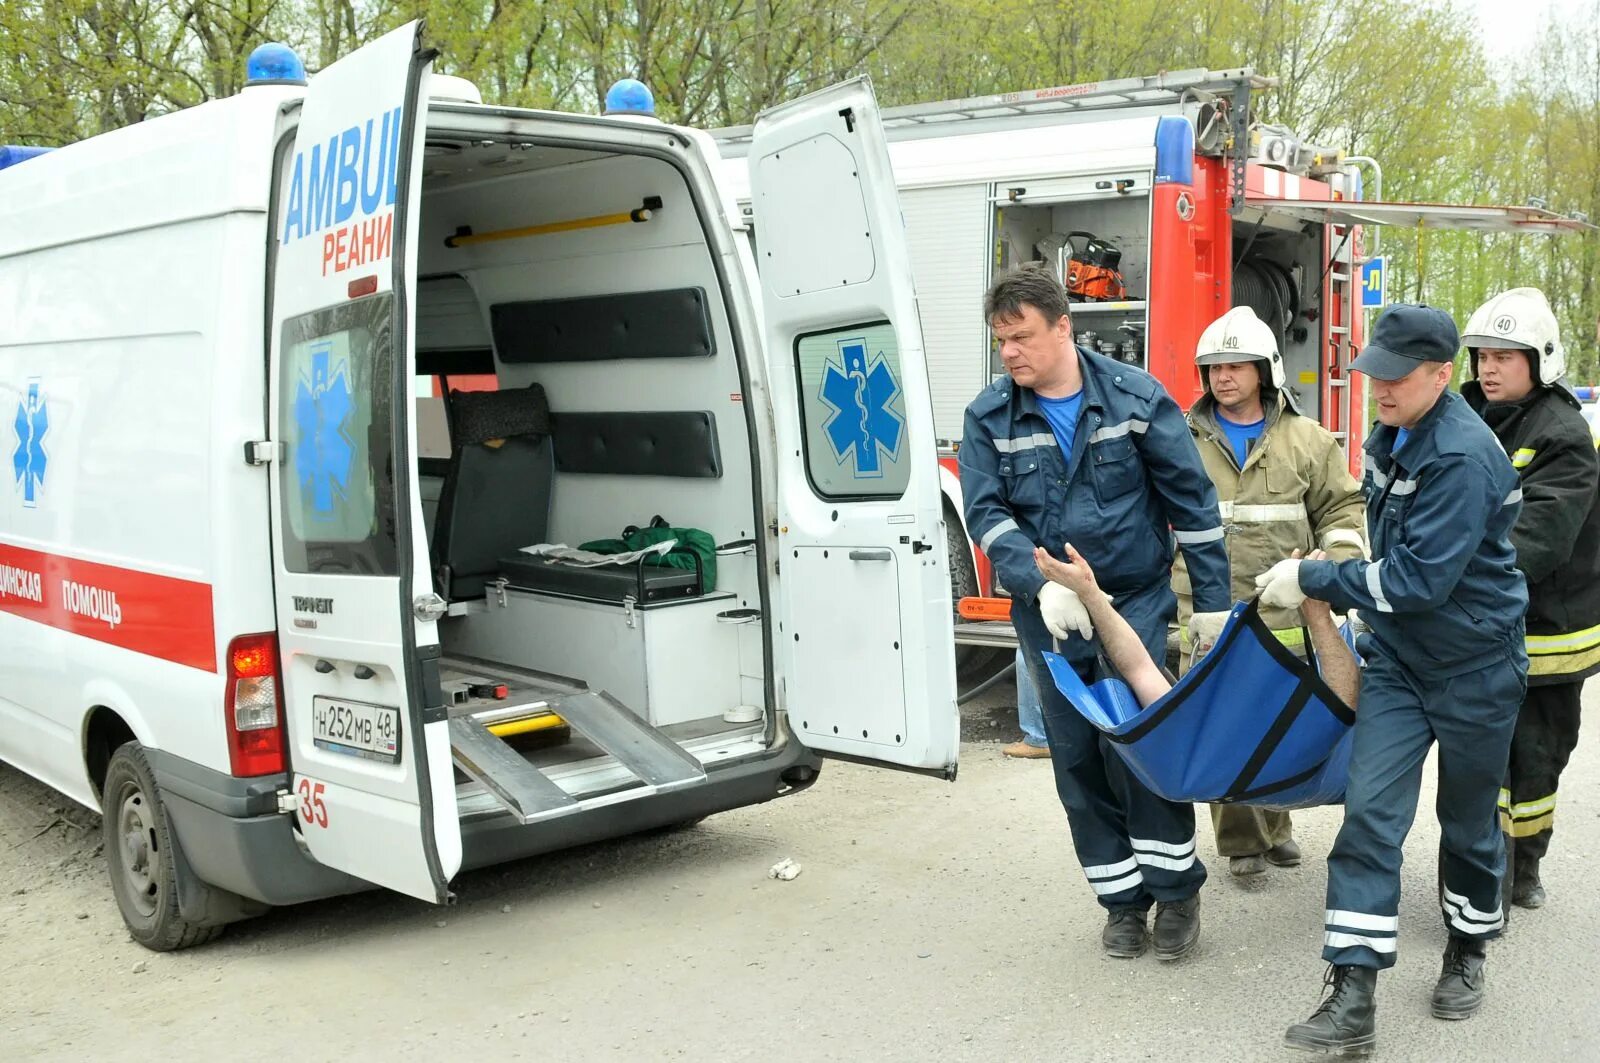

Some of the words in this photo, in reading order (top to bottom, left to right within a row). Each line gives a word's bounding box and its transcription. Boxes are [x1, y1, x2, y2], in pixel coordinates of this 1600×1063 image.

[322, 213, 393, 277] РЕАНИ
[1226, 336, 1238, 348] 40
[1497, 318, 1511, 331] 40
[62, 579, 122, 630] ПОМОЩЬ
[377, 711, 391, 738] 48
[298, 779, 328, 828] 35
